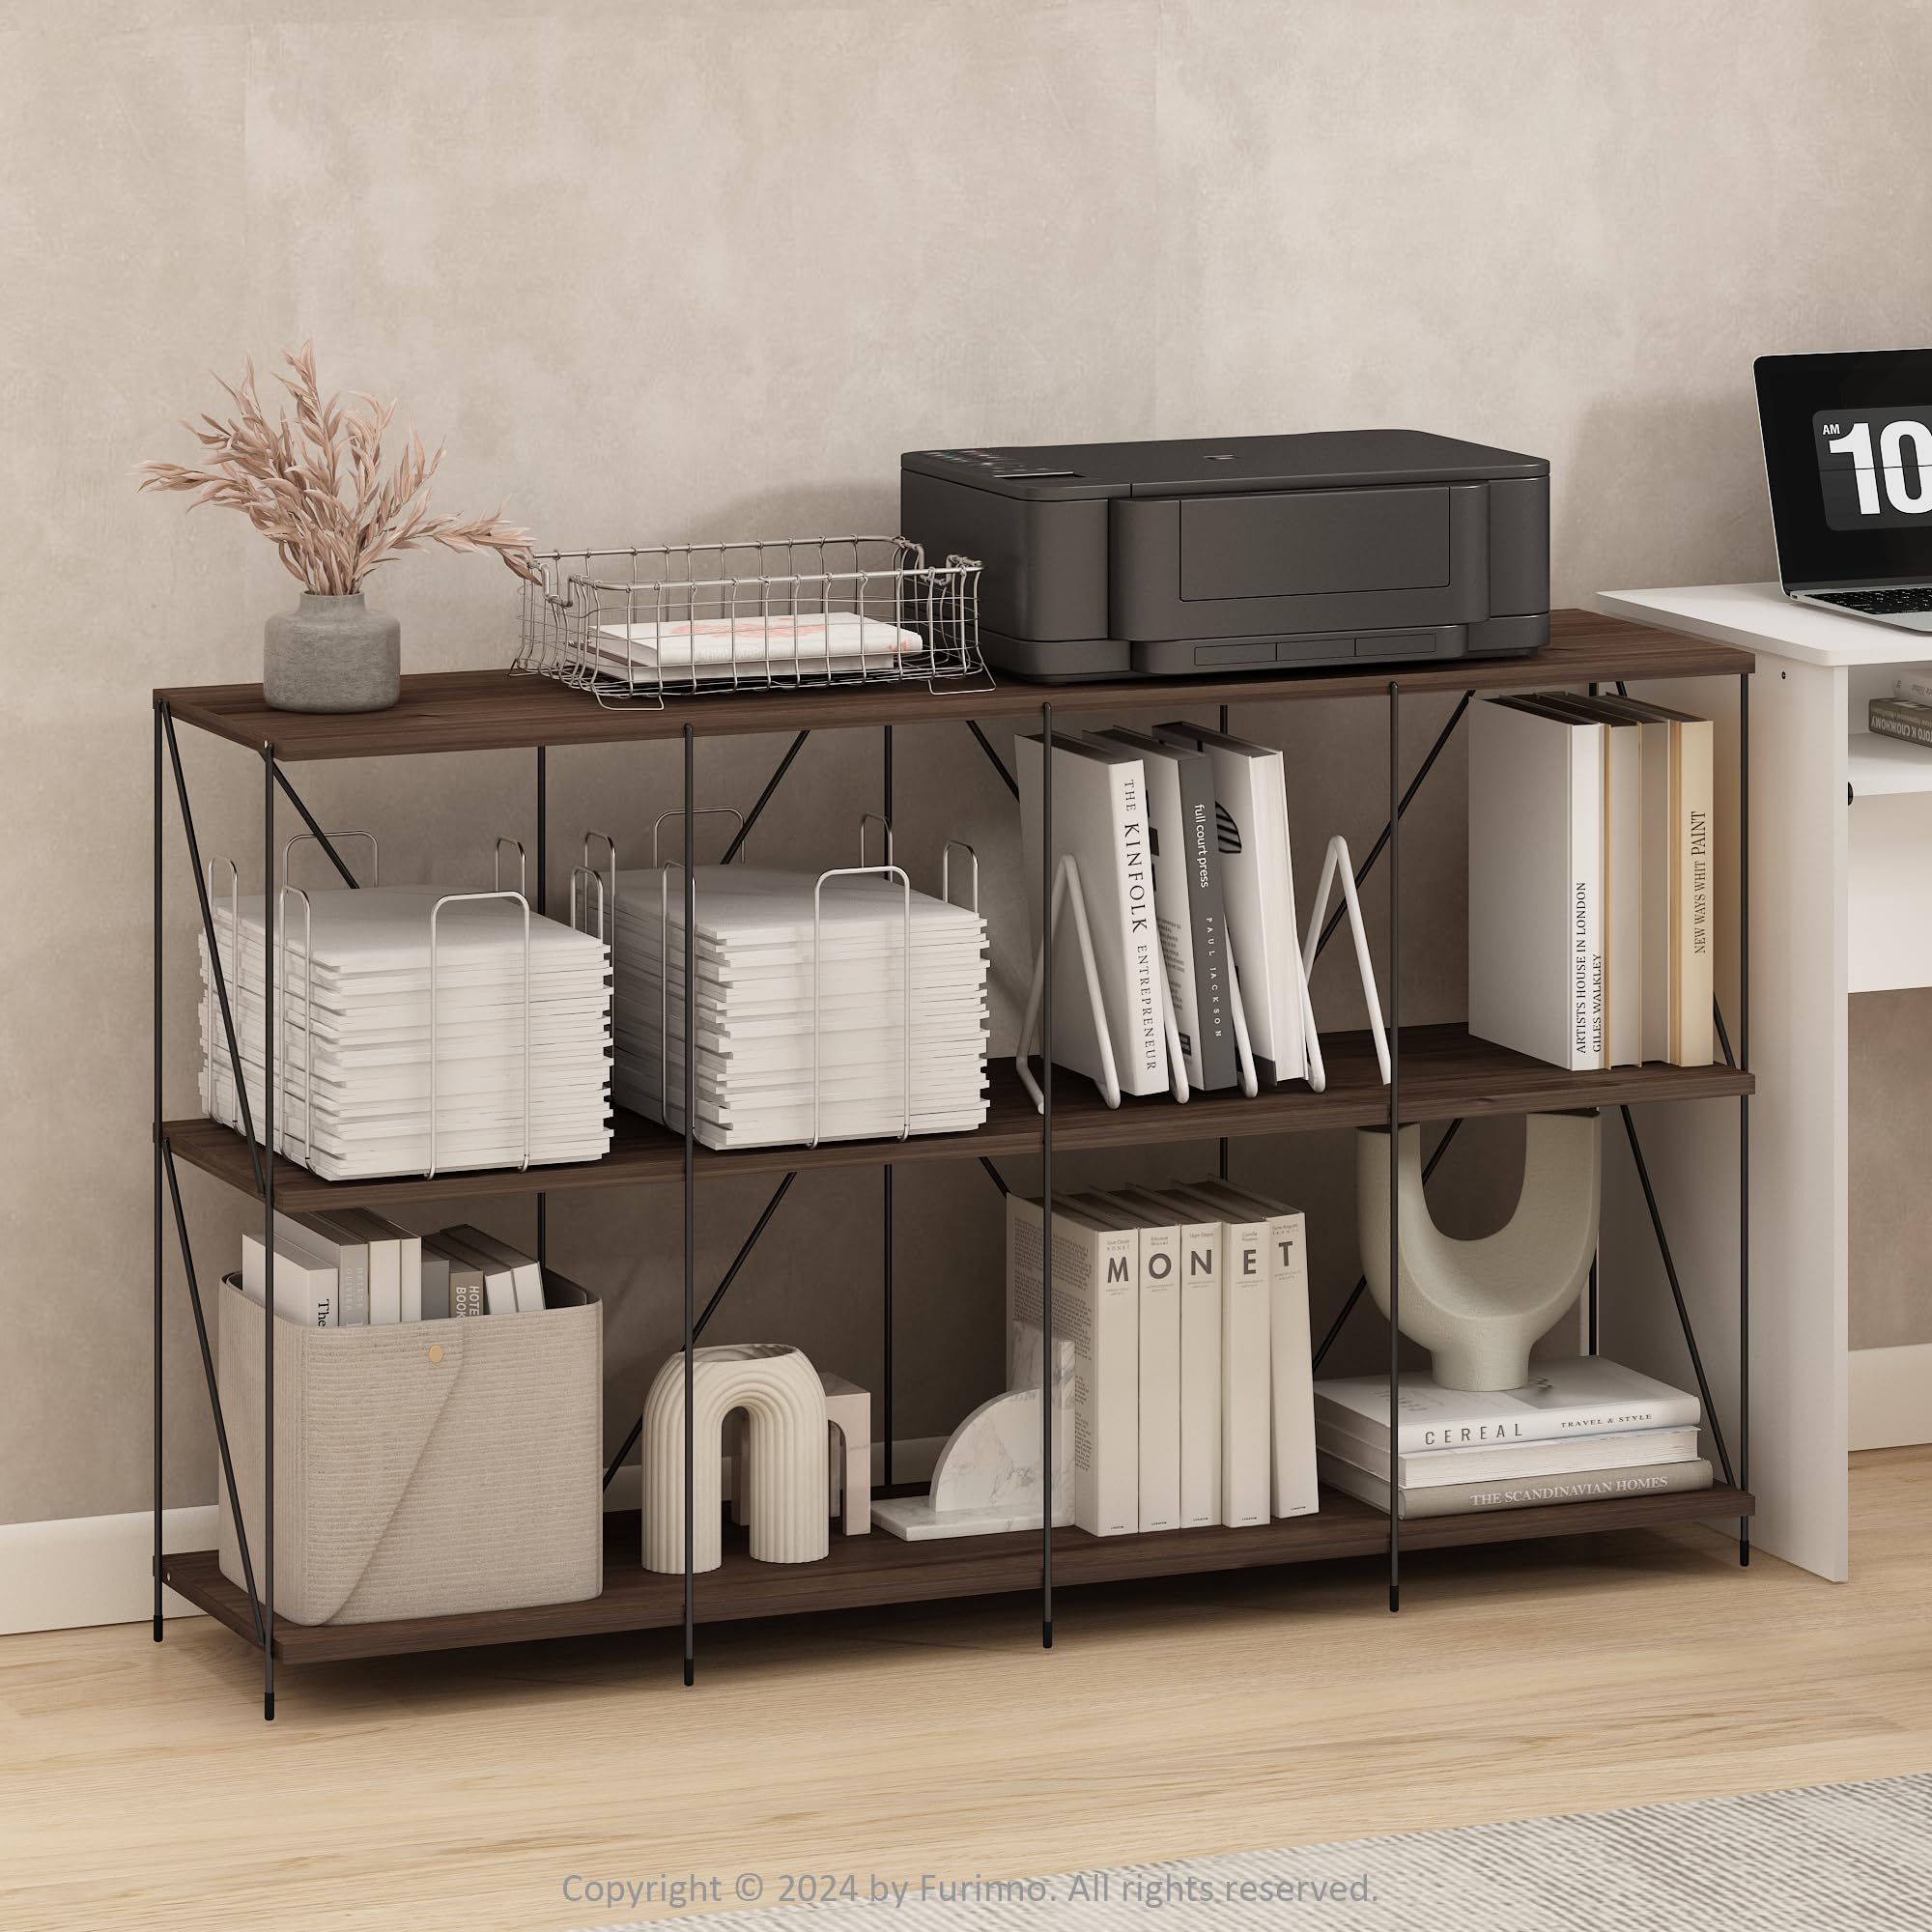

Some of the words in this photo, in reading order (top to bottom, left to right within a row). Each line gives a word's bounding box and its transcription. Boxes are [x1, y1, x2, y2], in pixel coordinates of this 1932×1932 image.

[1823, 423, 1840, 436] AM
[1829, 420, 1932, 515] 10
[1123, 779, 1137, 811] THE
[1194, 804, 1207, 823] full
[1196, 824, 1208, 856] court
[1690, 810, 1706, 856] PAINT
[1123, 823, 1148, 933] KINFOLK
[1197, 857, 1209, 889] press
[1694, 861, 1706, 893] WHIT
[1576, 881, 1586, 935] LONDON
[1694, 895, 1706, 925] WAYS
[1206, 917, 1215, 957] PAUL
[1576, 940, 1586, 953] IN
[1694, 928, 1706, 954] NEW
[1576, 956, 1586, 999] HOUSE
[1592, 953, 1603, 1014] WALKLEY
[1137, 945, 1157, 1070] ENTREPRENEUR
[1208, 967, 1223, 1037] JACKSON
[1576, 1003, 1586, 1054] ARTISTS
[1592, 1017, 1603, 1053] GILES
[318, 1298, 330, 1327] The
[1425, 1422, 1522, 1445] CEREAL
[1560, 1418, 1603, 1429] TRAVEL
[1618, 1413, 1653, 1423] STYLE
[1470, 1492, 1501, 1507] THE
[1504, 1482, 1612, 1503] SCANDINAVIAN
[1615, 1476, 1668, 1492] HOMES
